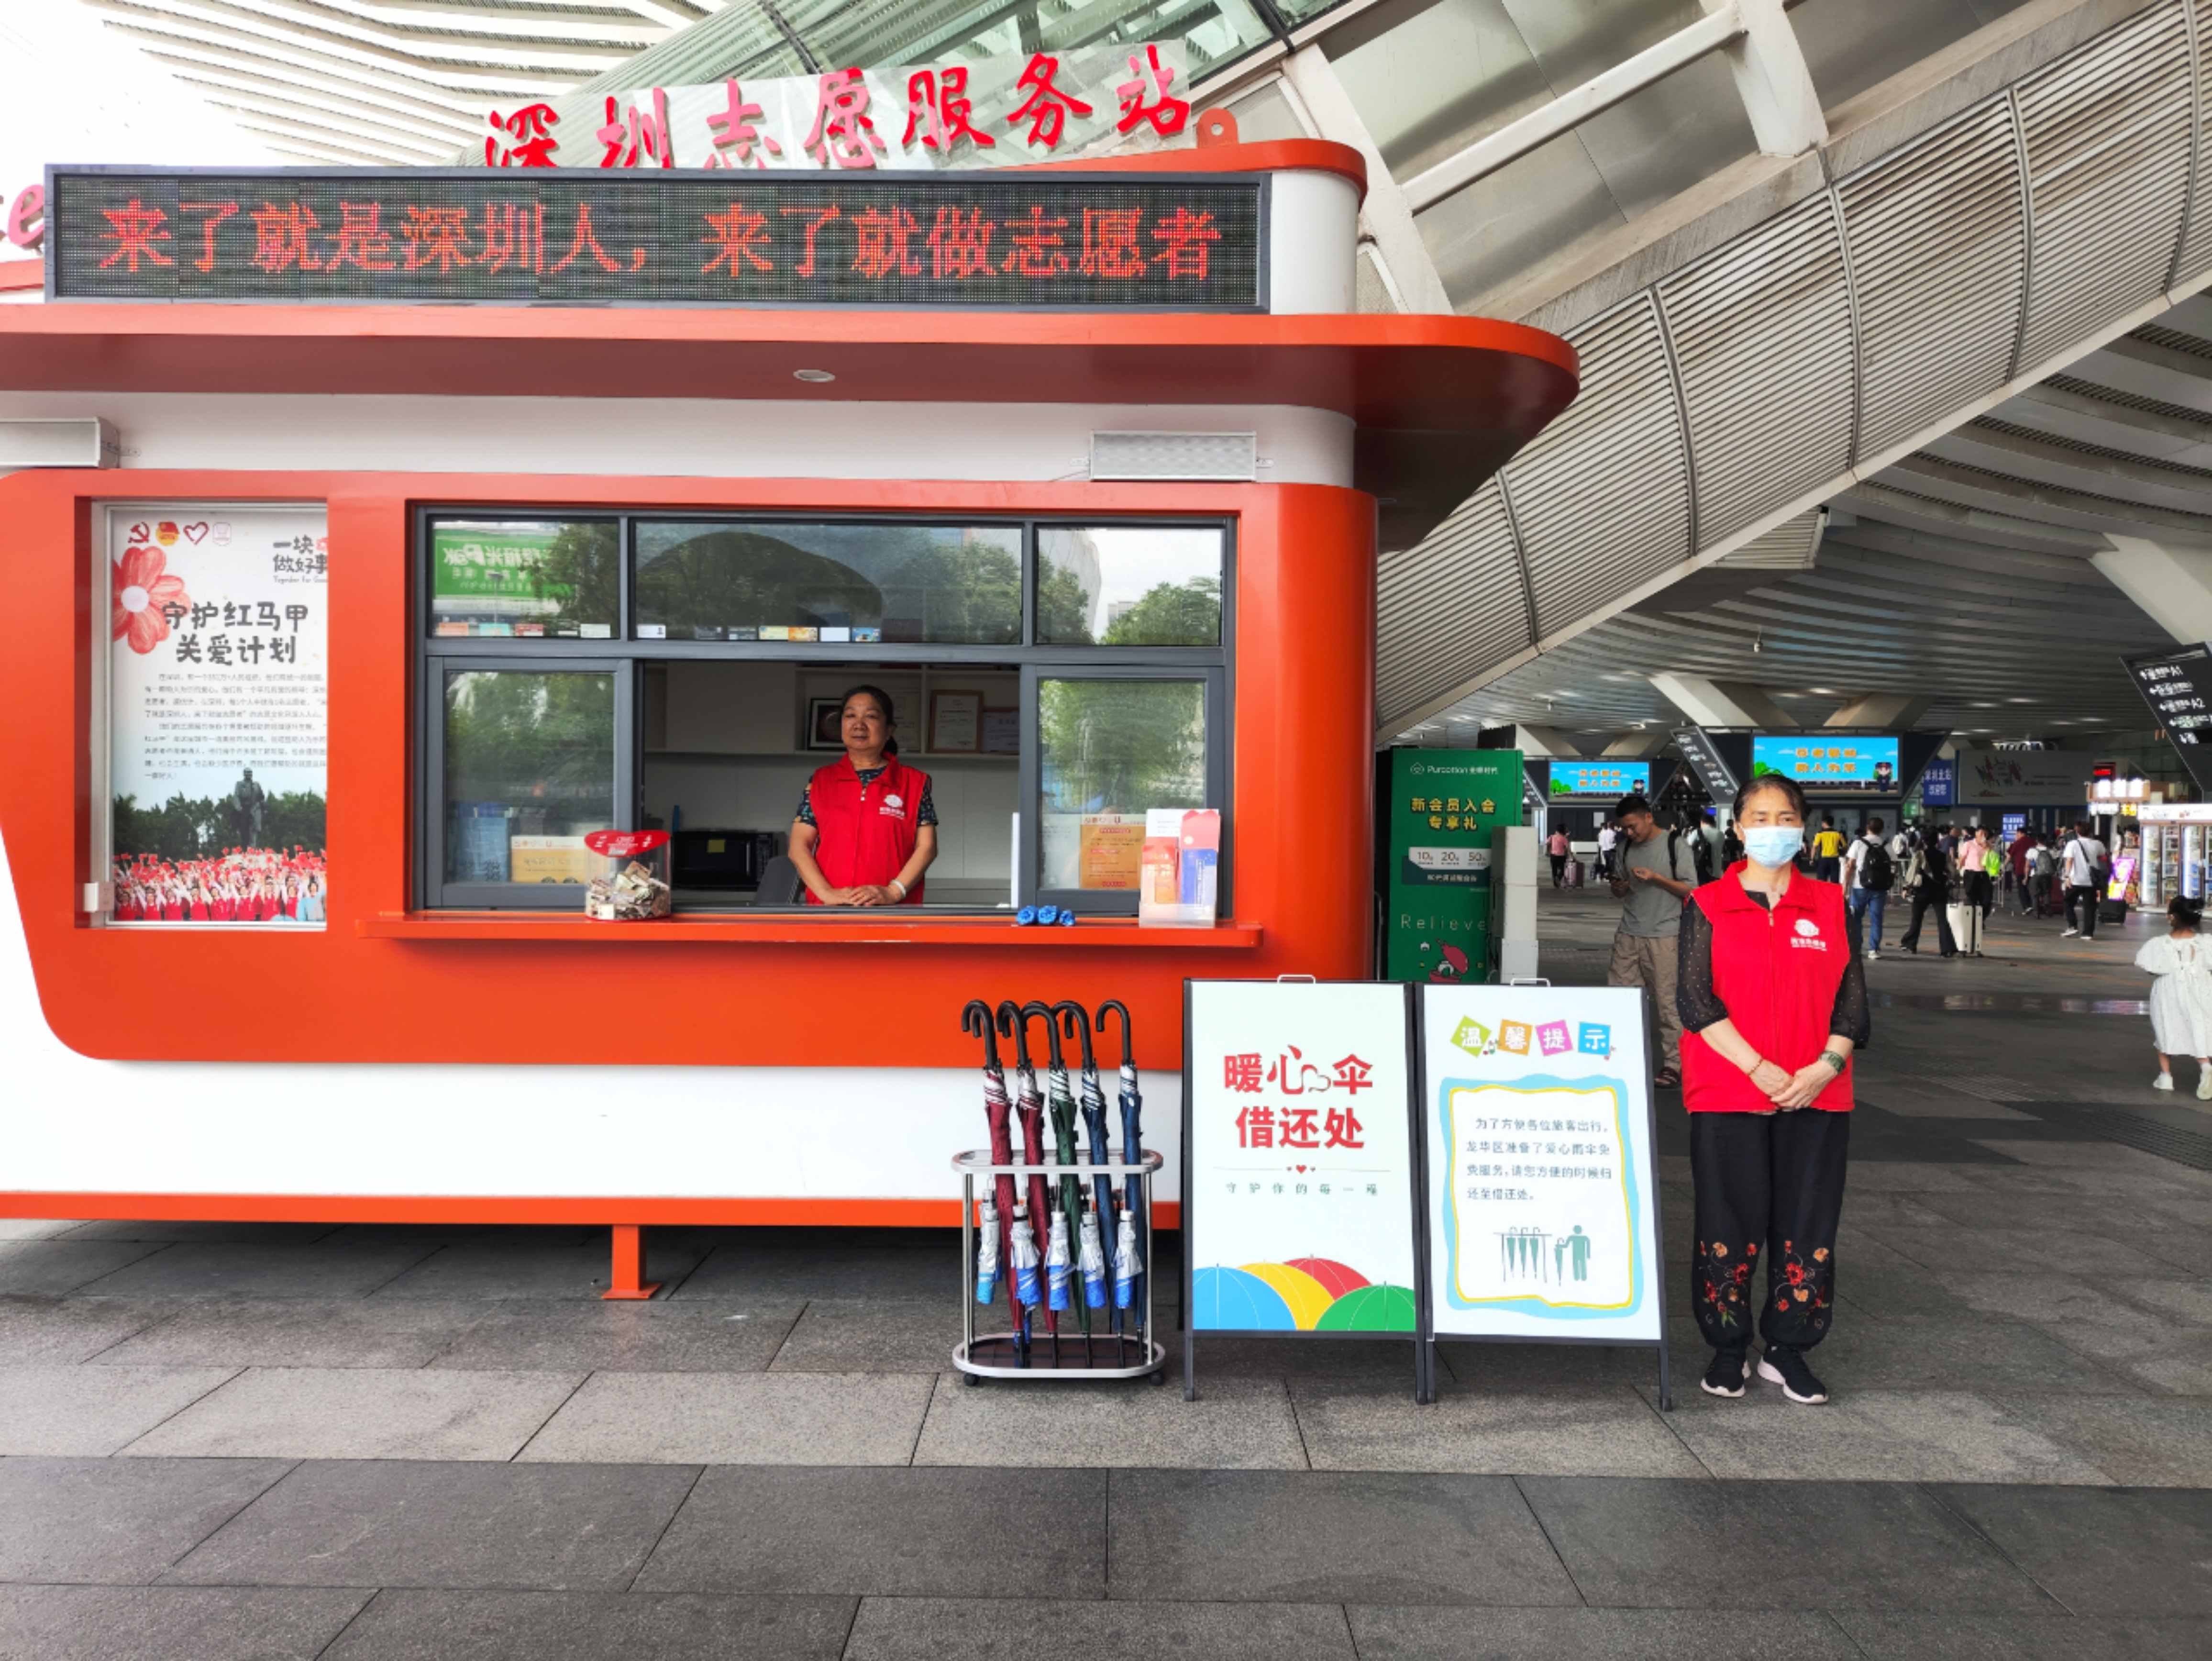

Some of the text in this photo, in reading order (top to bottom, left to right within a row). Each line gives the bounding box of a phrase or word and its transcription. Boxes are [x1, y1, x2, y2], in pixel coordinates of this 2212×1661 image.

[162, 601, 309, 632] 守护红马甲
[176, 634, 296, 666] 关爱计划
[1411, 798, 1495, 813] 新会员入会
[1429, 816, 1477, 830] 专享礼
[1460, 1025, 1606, 1050] 温馨提示
[1224, 1044, 1373, 1095] 暖心伞
[1235, 1106, 1365, 1149] 借还处
